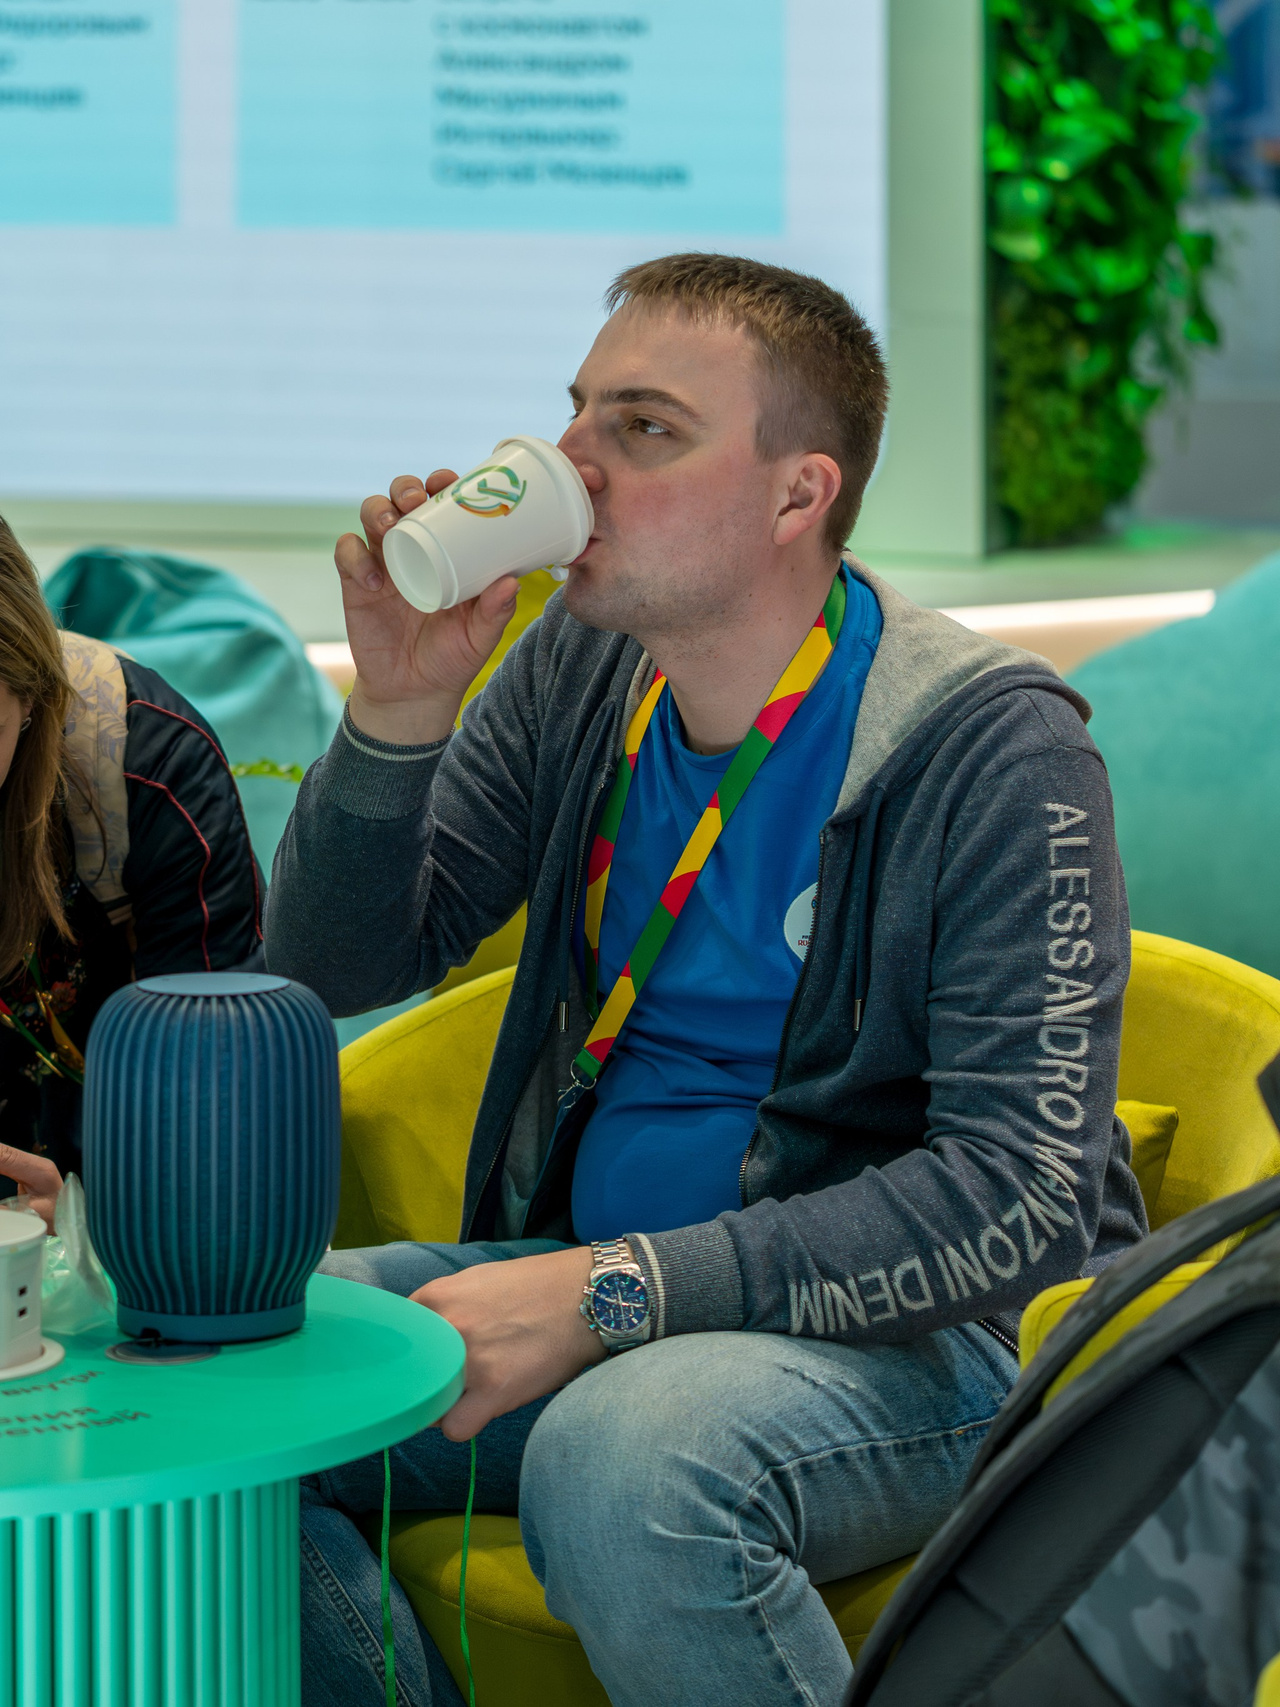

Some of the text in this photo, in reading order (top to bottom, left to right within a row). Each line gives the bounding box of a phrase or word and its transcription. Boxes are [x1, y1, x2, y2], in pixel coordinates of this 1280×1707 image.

[1036, 800, 1098, 1131] ALESSANDRO
[788, 1255, 936, 1336] DENIM
[1, 1369, 106, 1396] внутри
